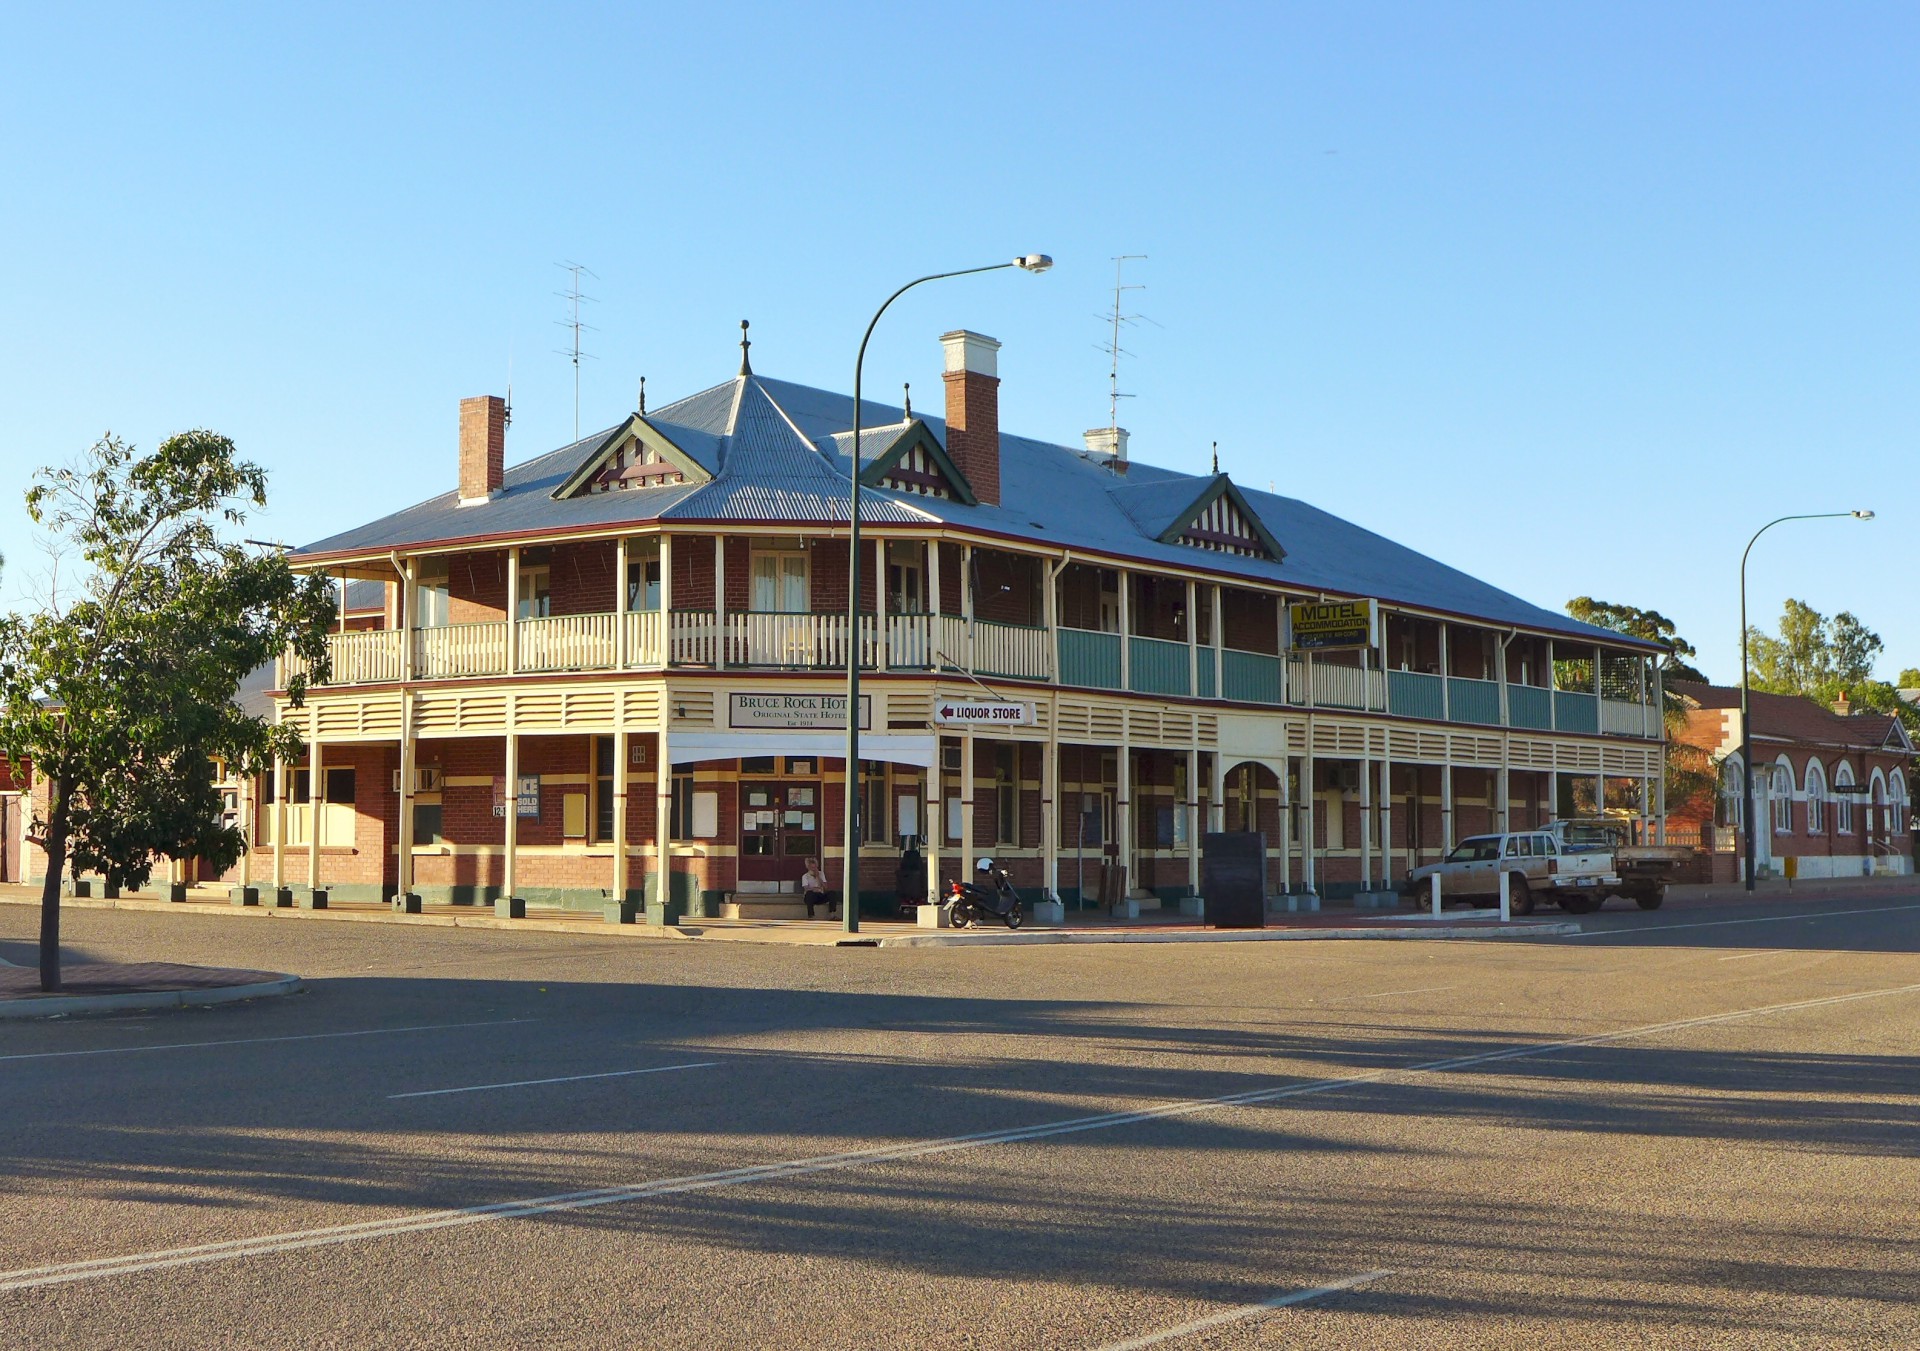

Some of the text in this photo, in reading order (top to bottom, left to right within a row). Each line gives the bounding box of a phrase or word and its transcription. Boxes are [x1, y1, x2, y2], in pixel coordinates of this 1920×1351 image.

[1301, 603, 1362, 620] MOTEL
[1293, 617, 1369, 630] ACCOMMODATION
[739, 696, 861, 710] BRUCE ROCK HOT
[752, 710, 790, 718] ORIGINAL
[793, 711, 818, 719] STATE
[956, 707, 1021, 720] LIQUOR STORE
[517, 779, 538, 794] ICE
